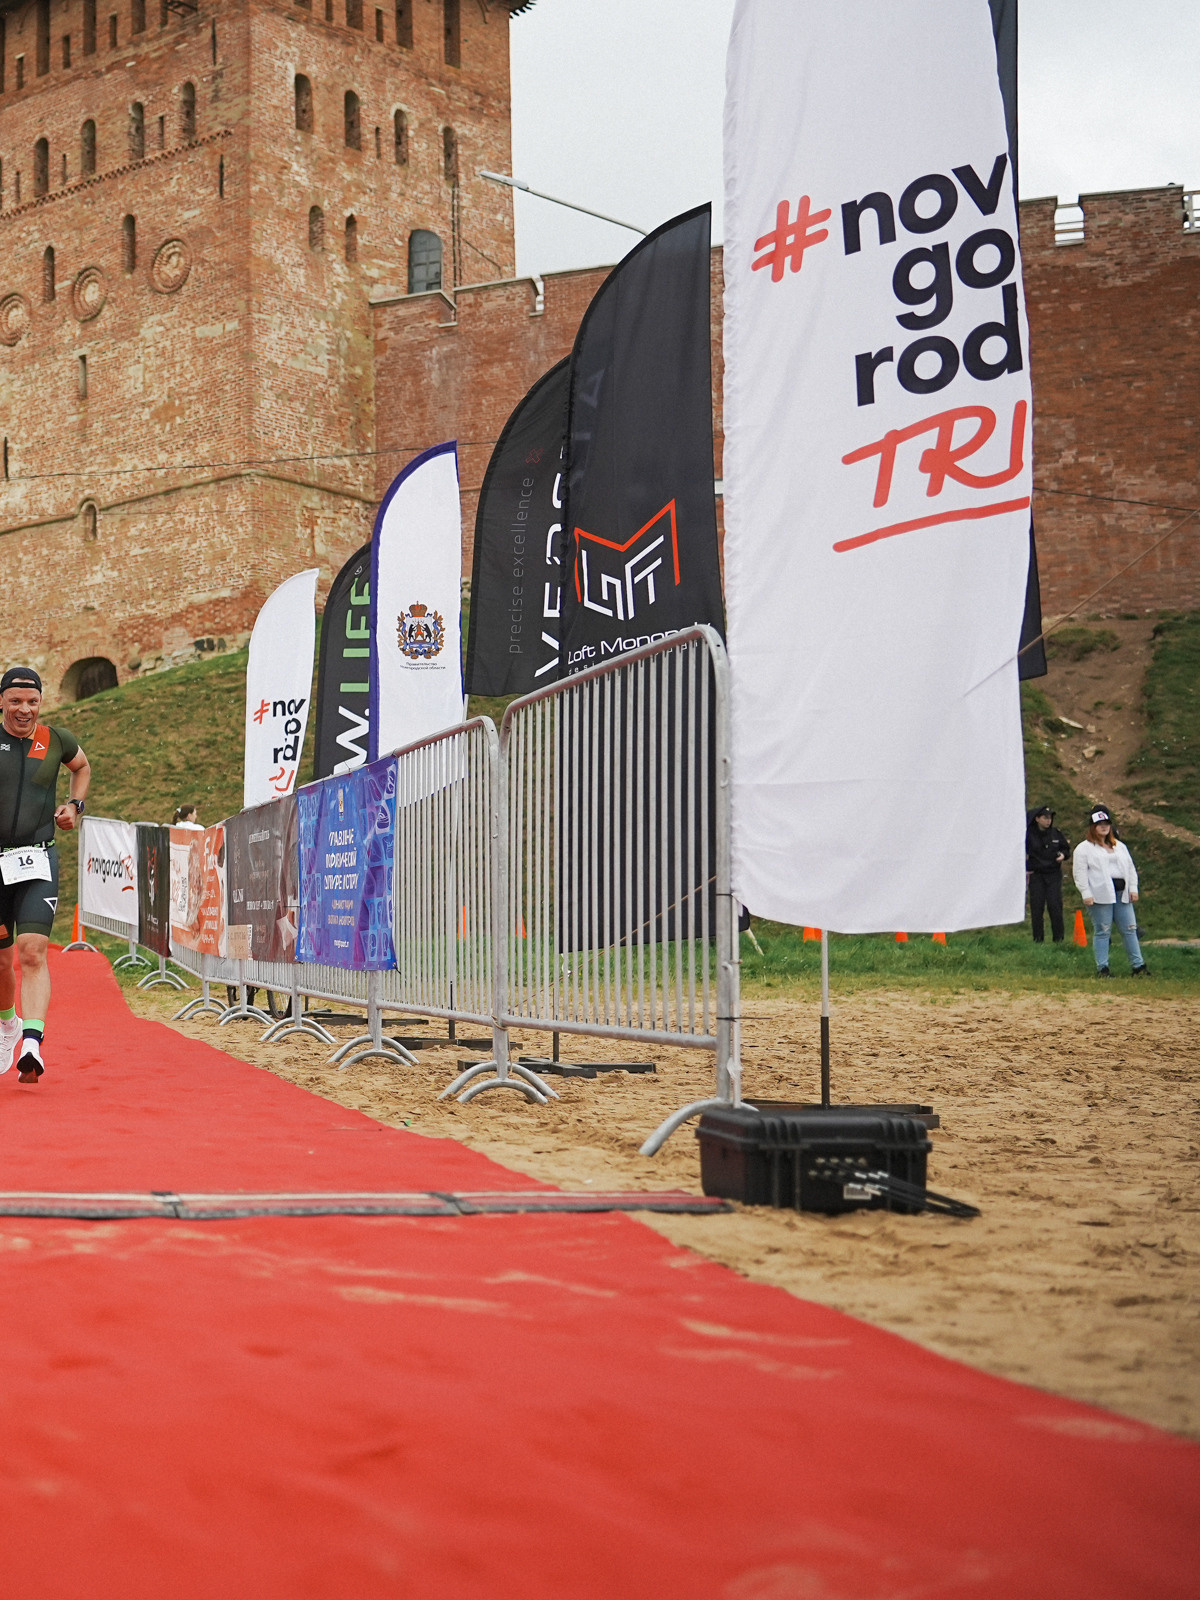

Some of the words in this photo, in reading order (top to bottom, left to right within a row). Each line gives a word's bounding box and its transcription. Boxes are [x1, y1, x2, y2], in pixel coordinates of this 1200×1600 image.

[751, 152, 1009, 283] #nov
[892, 228, 1016, 331] go
[855, 282, 1024, 407] rod
[841, 400, 1028, 508] TRI
[18, 855, 34, 867] 16
